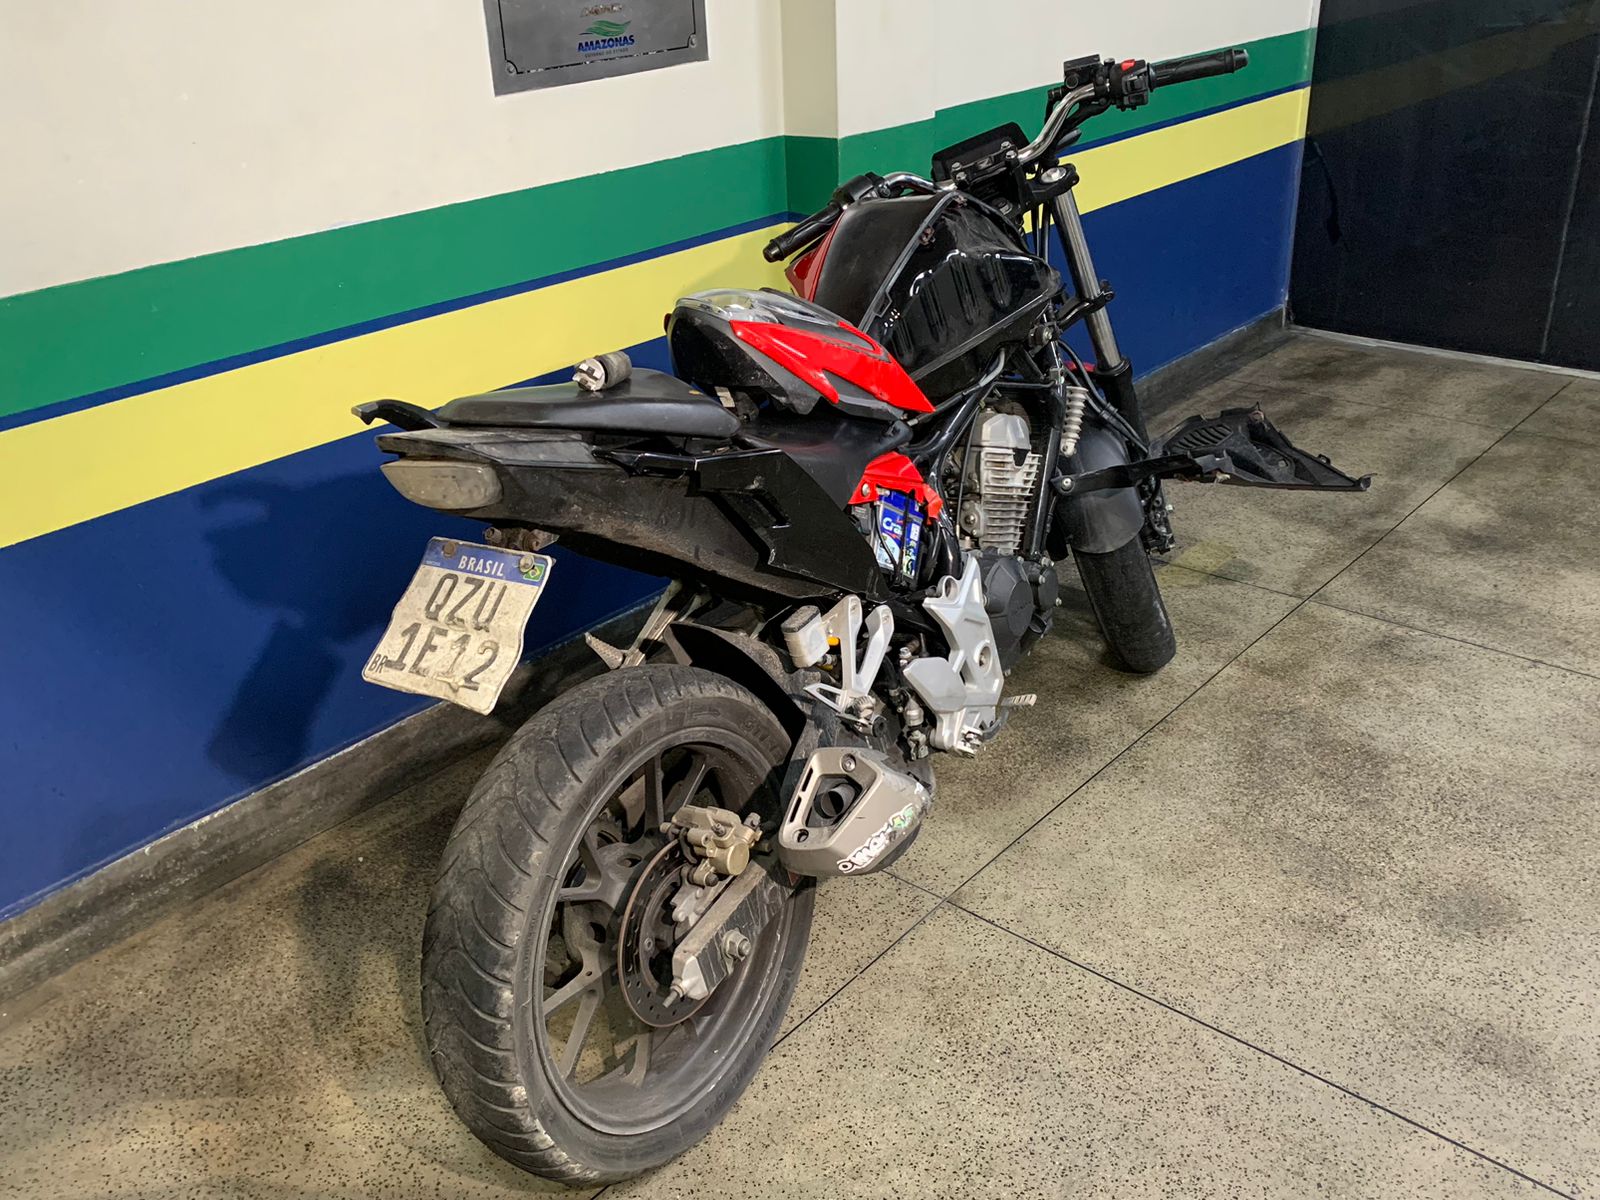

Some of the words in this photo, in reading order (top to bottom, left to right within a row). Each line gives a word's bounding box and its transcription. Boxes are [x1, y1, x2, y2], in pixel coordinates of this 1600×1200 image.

[577, 34, 635, 52] AMAZONAS
[458, 555, 505, 577] BRASIL
[424, 573, 507, 632] QZU
[368, 654, 388, 673] BR
[384, 622, 499, 691] 1E12
